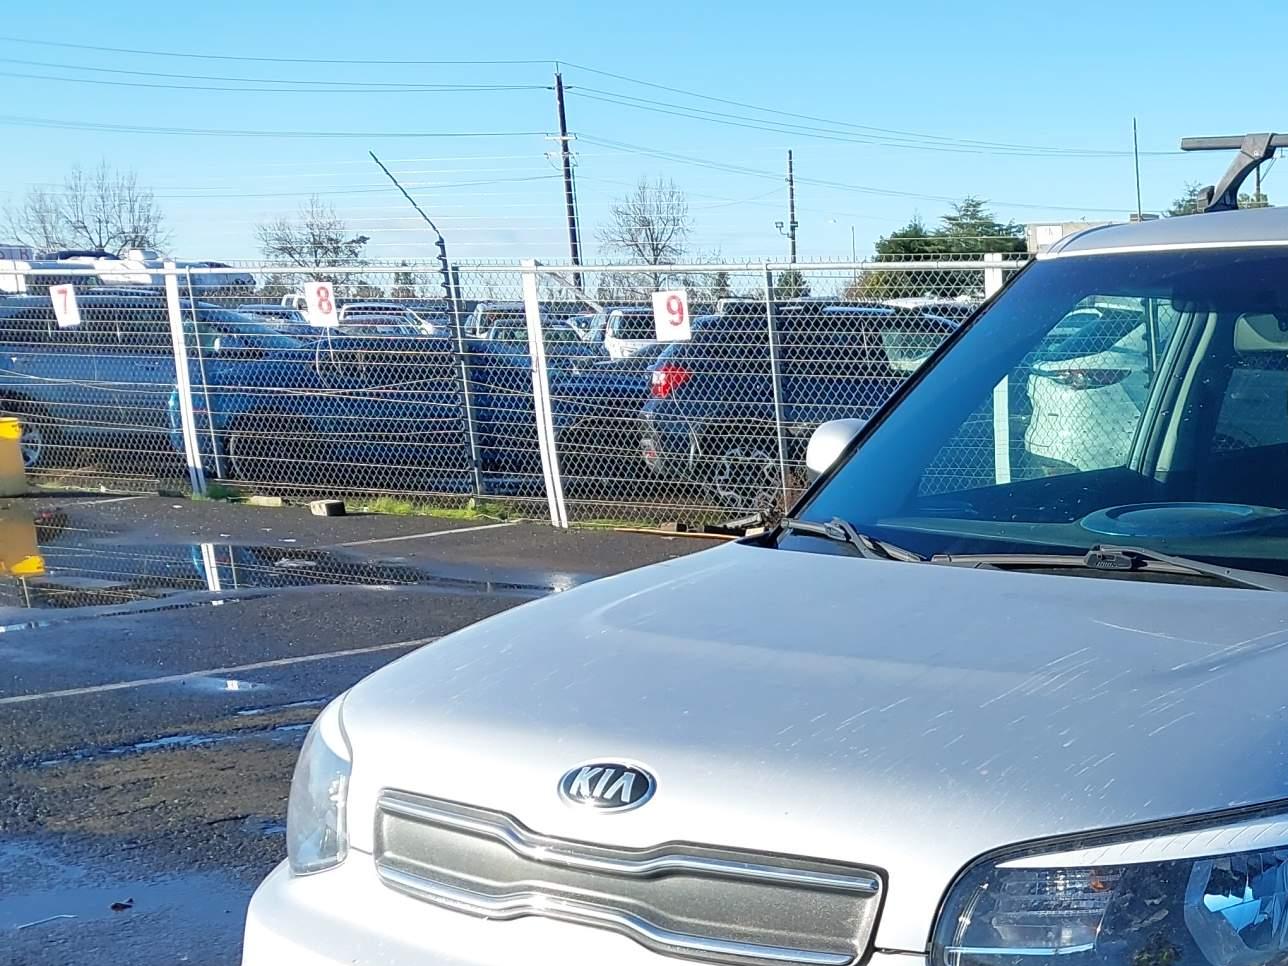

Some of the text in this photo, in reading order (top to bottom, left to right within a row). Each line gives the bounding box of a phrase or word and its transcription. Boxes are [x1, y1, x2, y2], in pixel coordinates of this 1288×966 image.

[57, 288, 68, 315] 7
[316, 286, 332, 315] 8
[666, 295, 684, 326] 9
[569, 766, 636, 804] KIA
